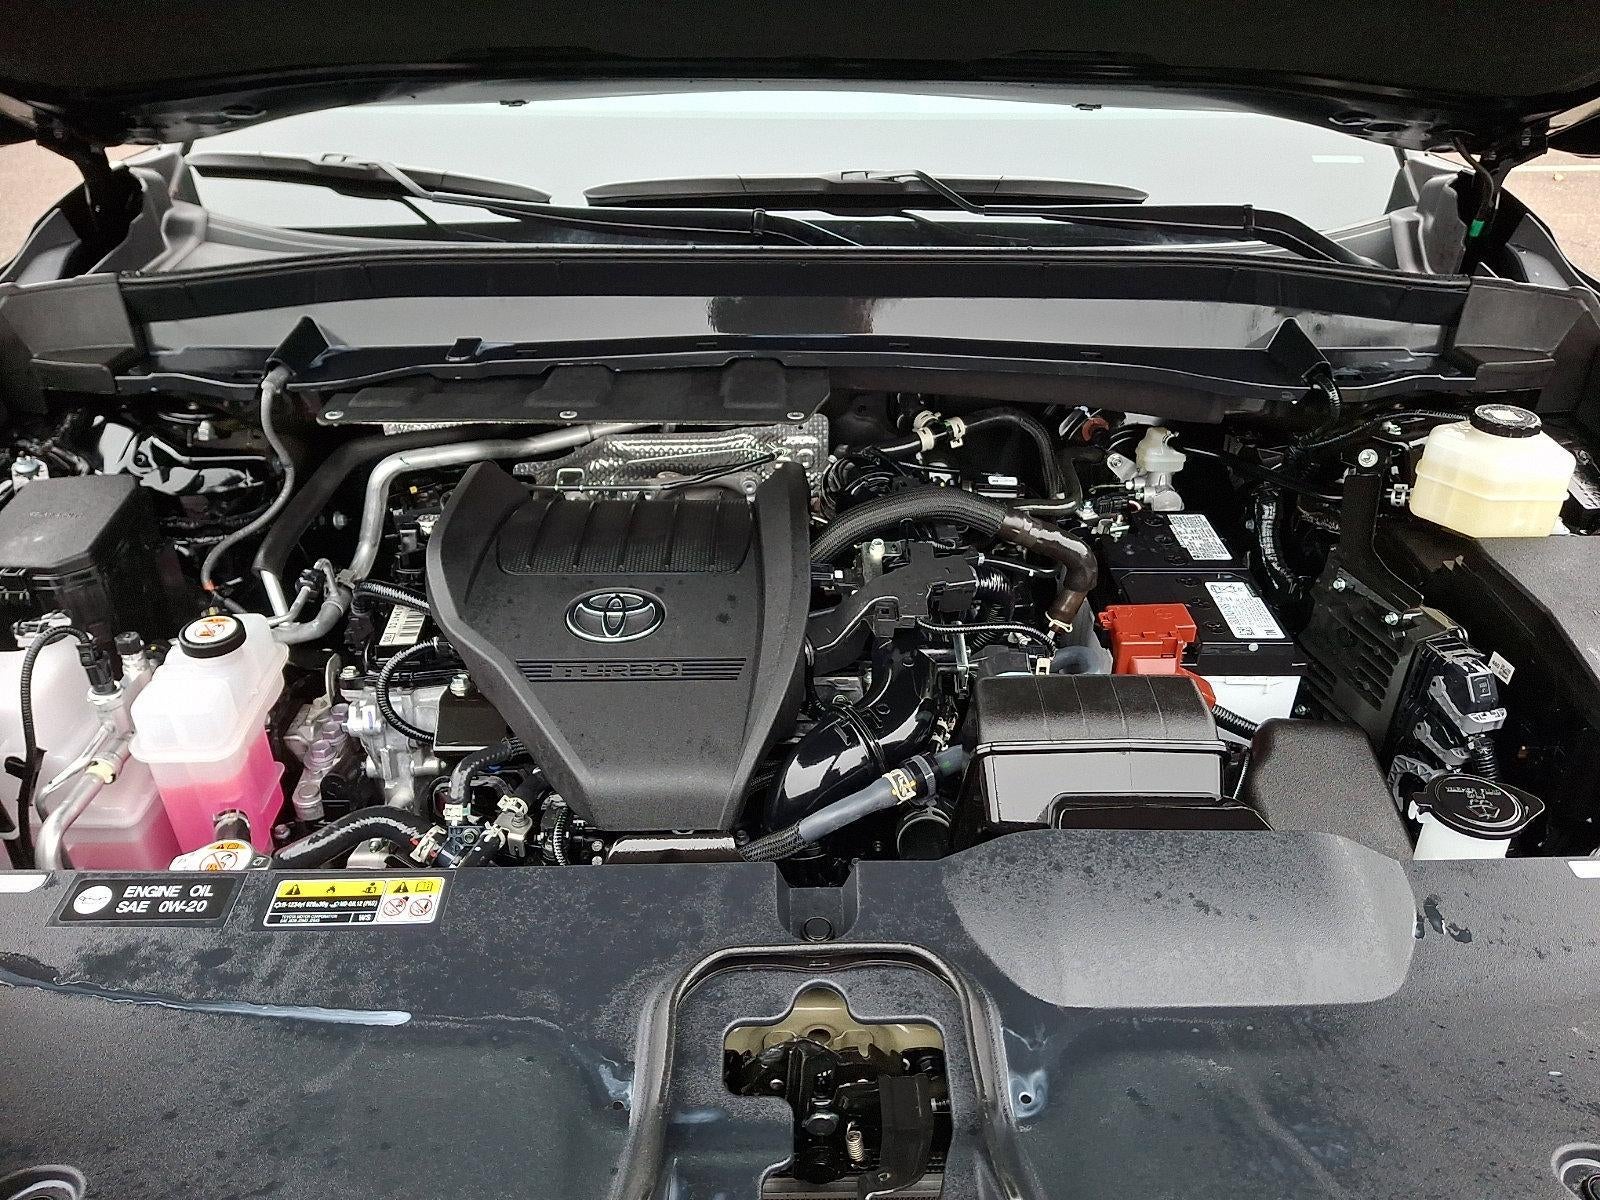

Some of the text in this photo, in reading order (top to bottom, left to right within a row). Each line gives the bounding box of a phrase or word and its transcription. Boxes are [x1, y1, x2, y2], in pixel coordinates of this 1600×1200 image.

[551, 662, 682, 678] TURBO
[123, 885, 214, 898] ENGINE OIL
[115, 900, 208, 913] SAE 0W-20
